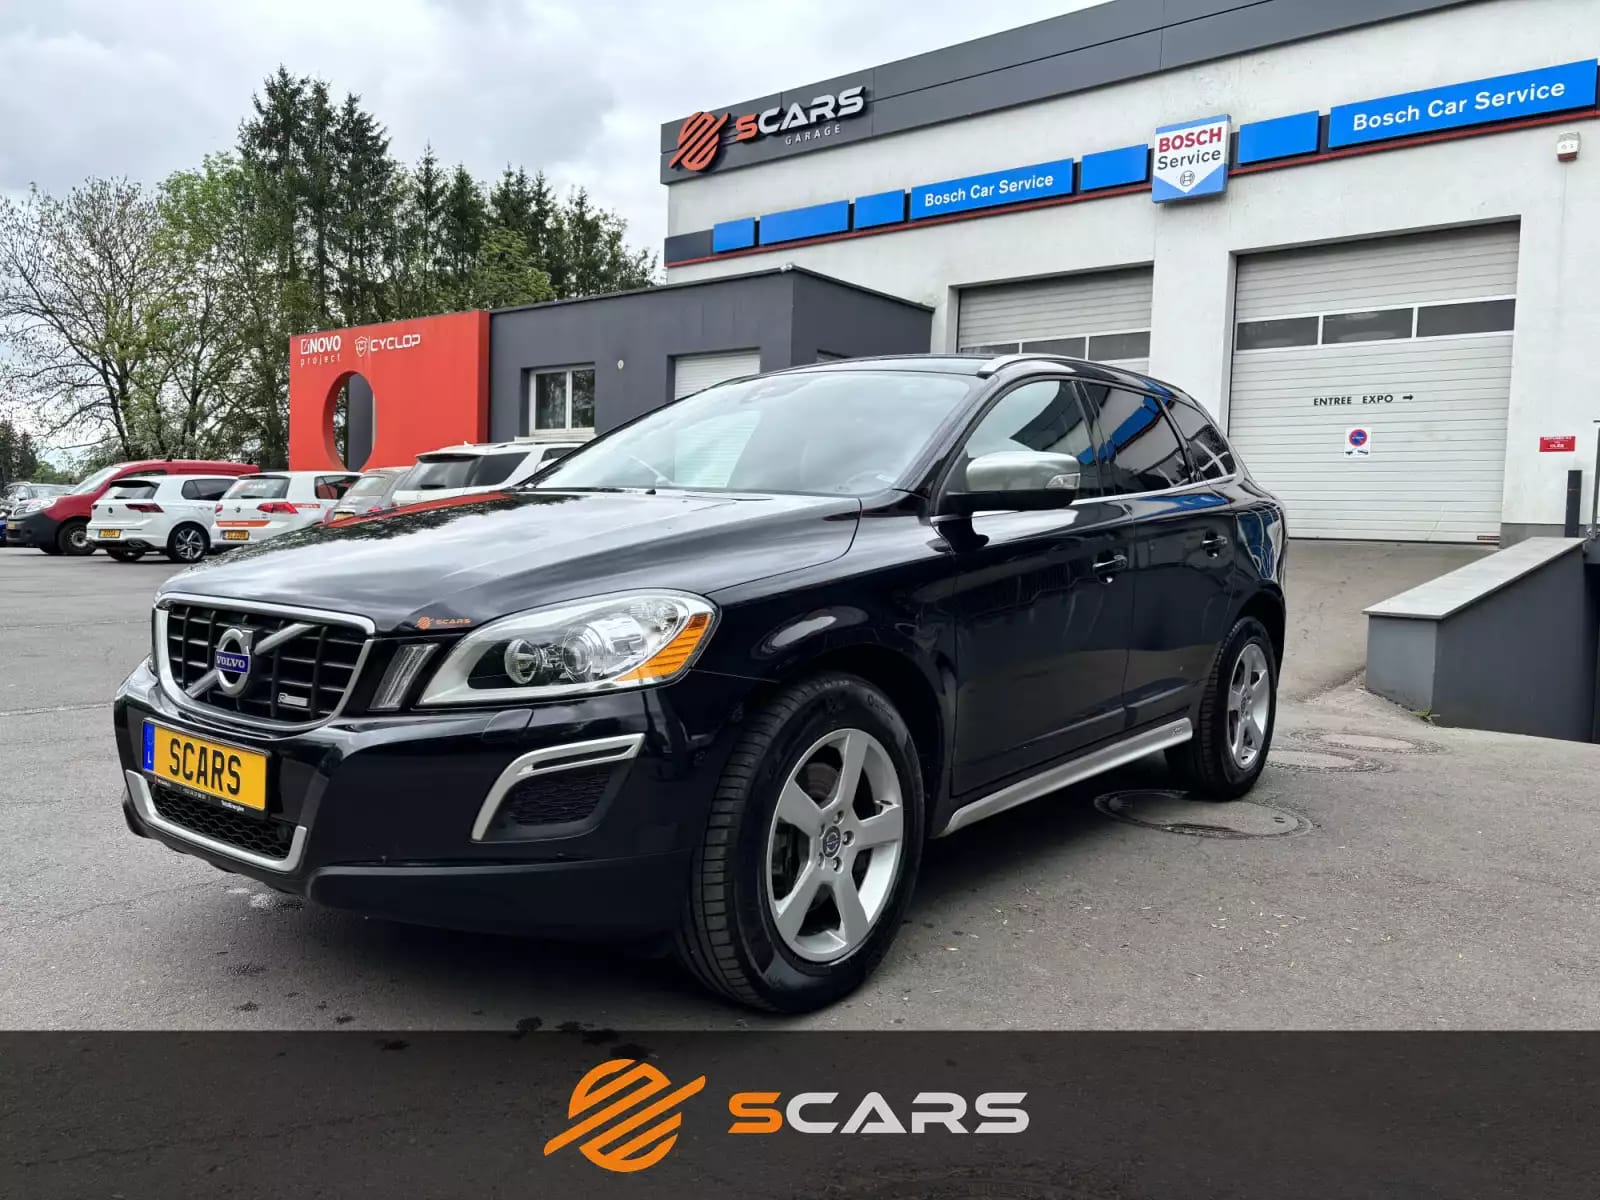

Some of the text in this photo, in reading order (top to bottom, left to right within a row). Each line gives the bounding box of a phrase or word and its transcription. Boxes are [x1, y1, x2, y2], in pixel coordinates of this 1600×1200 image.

[735, 85, 865, 141] SCARS
[1353, 82, 1566, 131] Bosch Car Service
[785, 123, 841, 145] GARAGE
[1158, 126, 1223, 153] BOSCH
[1157, 149, 1221, 171] Service
[925, 174, 1054, 207] Bosch Car Service
[370, 333, 421, 352] CYCLOP
[300, 352, 341, 369] project
[1313, 394, 1394, 406] ENTREE EXPO
[435, 617, 472, 625] SCARS
[216, 655, 246, 669] VOLVO
[169, 737, 242, 796] SCARS
